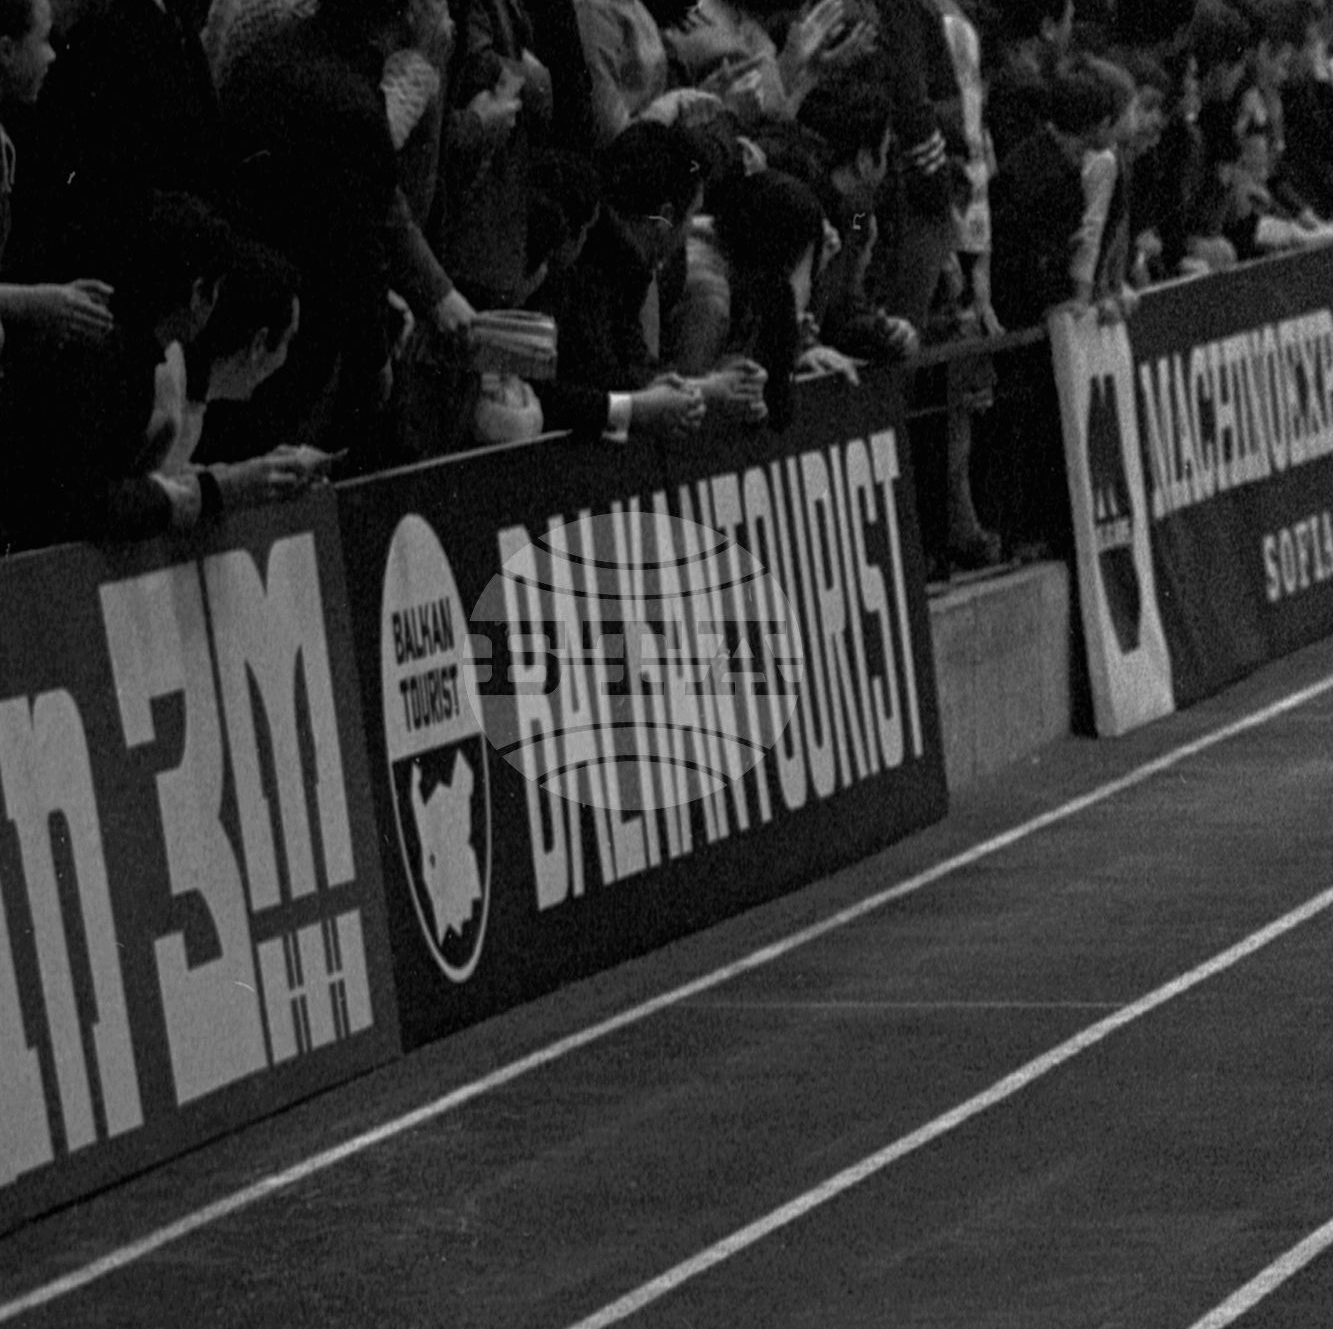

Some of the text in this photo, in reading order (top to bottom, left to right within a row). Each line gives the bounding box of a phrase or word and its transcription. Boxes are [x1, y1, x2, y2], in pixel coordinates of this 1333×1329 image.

[391, 595, 455, 667] BALKAN
[399, 662, 461, 734] TOURIST
[497, 427, 923, 912] BALKANTOURIST
